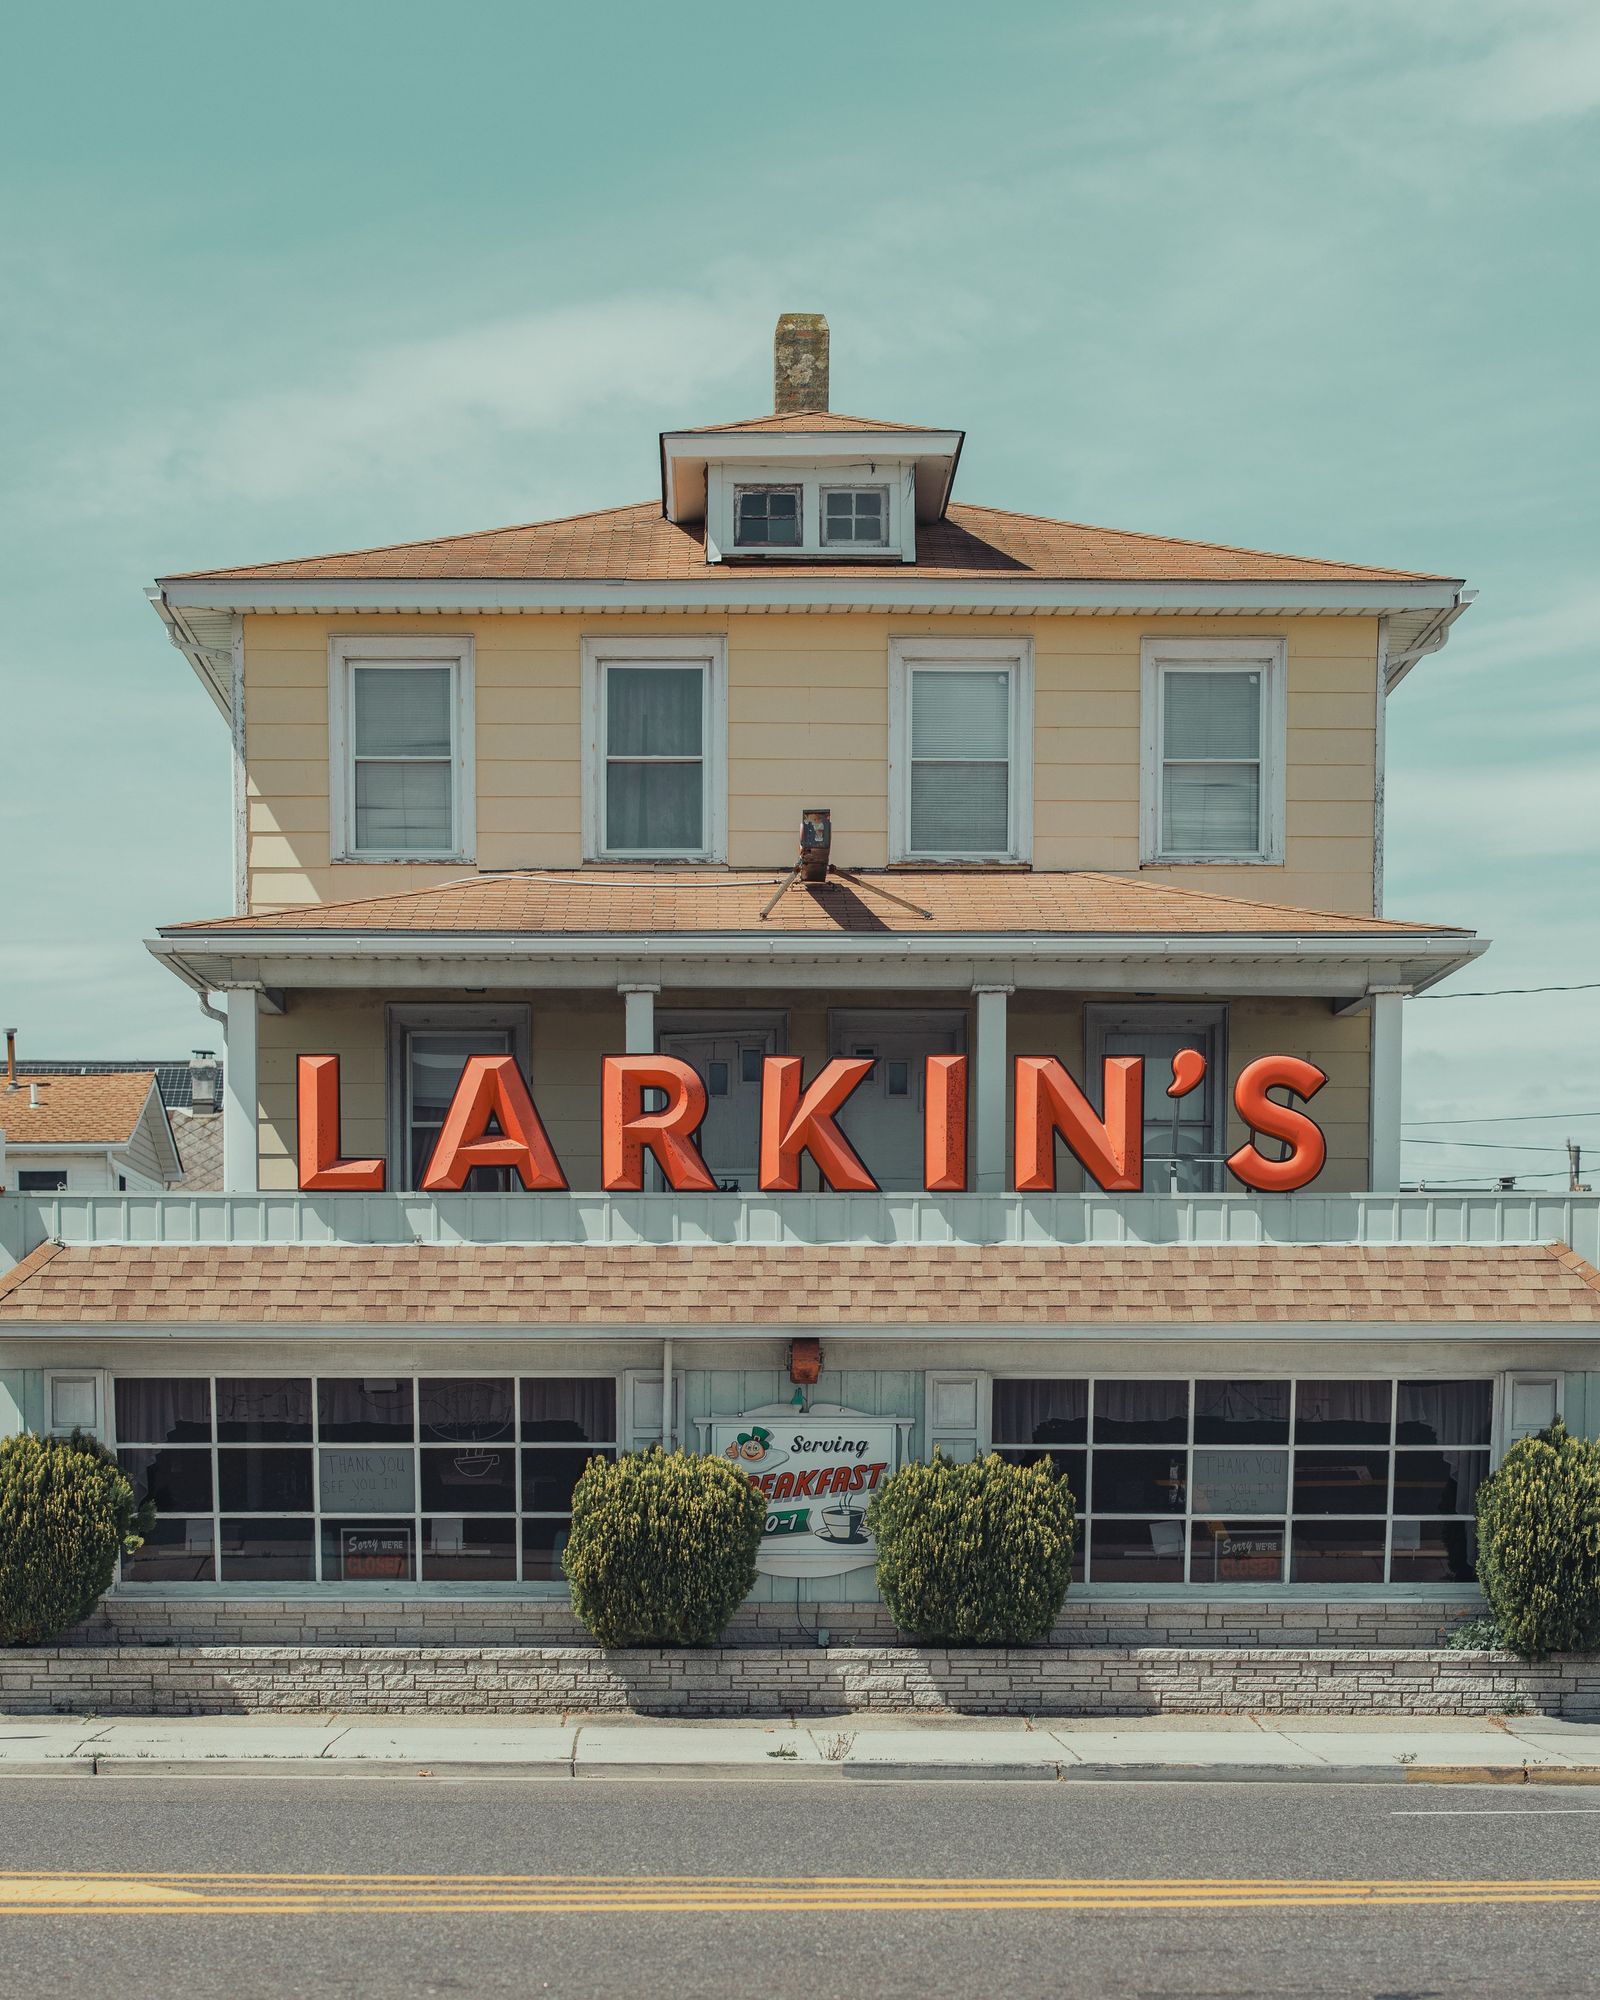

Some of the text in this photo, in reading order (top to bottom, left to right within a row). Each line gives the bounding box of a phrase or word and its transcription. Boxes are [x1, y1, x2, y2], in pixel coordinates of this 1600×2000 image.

[296, 1048, 1328, 1193] LARKIN'S
[791, 1435, 869, 1459] Serving
[326, 1455, 405, 1476] THANK YOU
[1200, 1456, 1282, 1476] THANK YOU
[321, 1478, 398, 1497] SEE YOU IN
[748, 1463, 887, 1499] EAKFAST
[1196, 1482, 1275, 1500] SEE YOU IN
[348, 1536, 403, 1553] Sorry WE'RE
[1222, 1538, 1278, 1555] Sorry WE'RE
[347, 1556, 405, 1575] CLOSED
[1221, 1558, 1278, 1578] CLOSED
